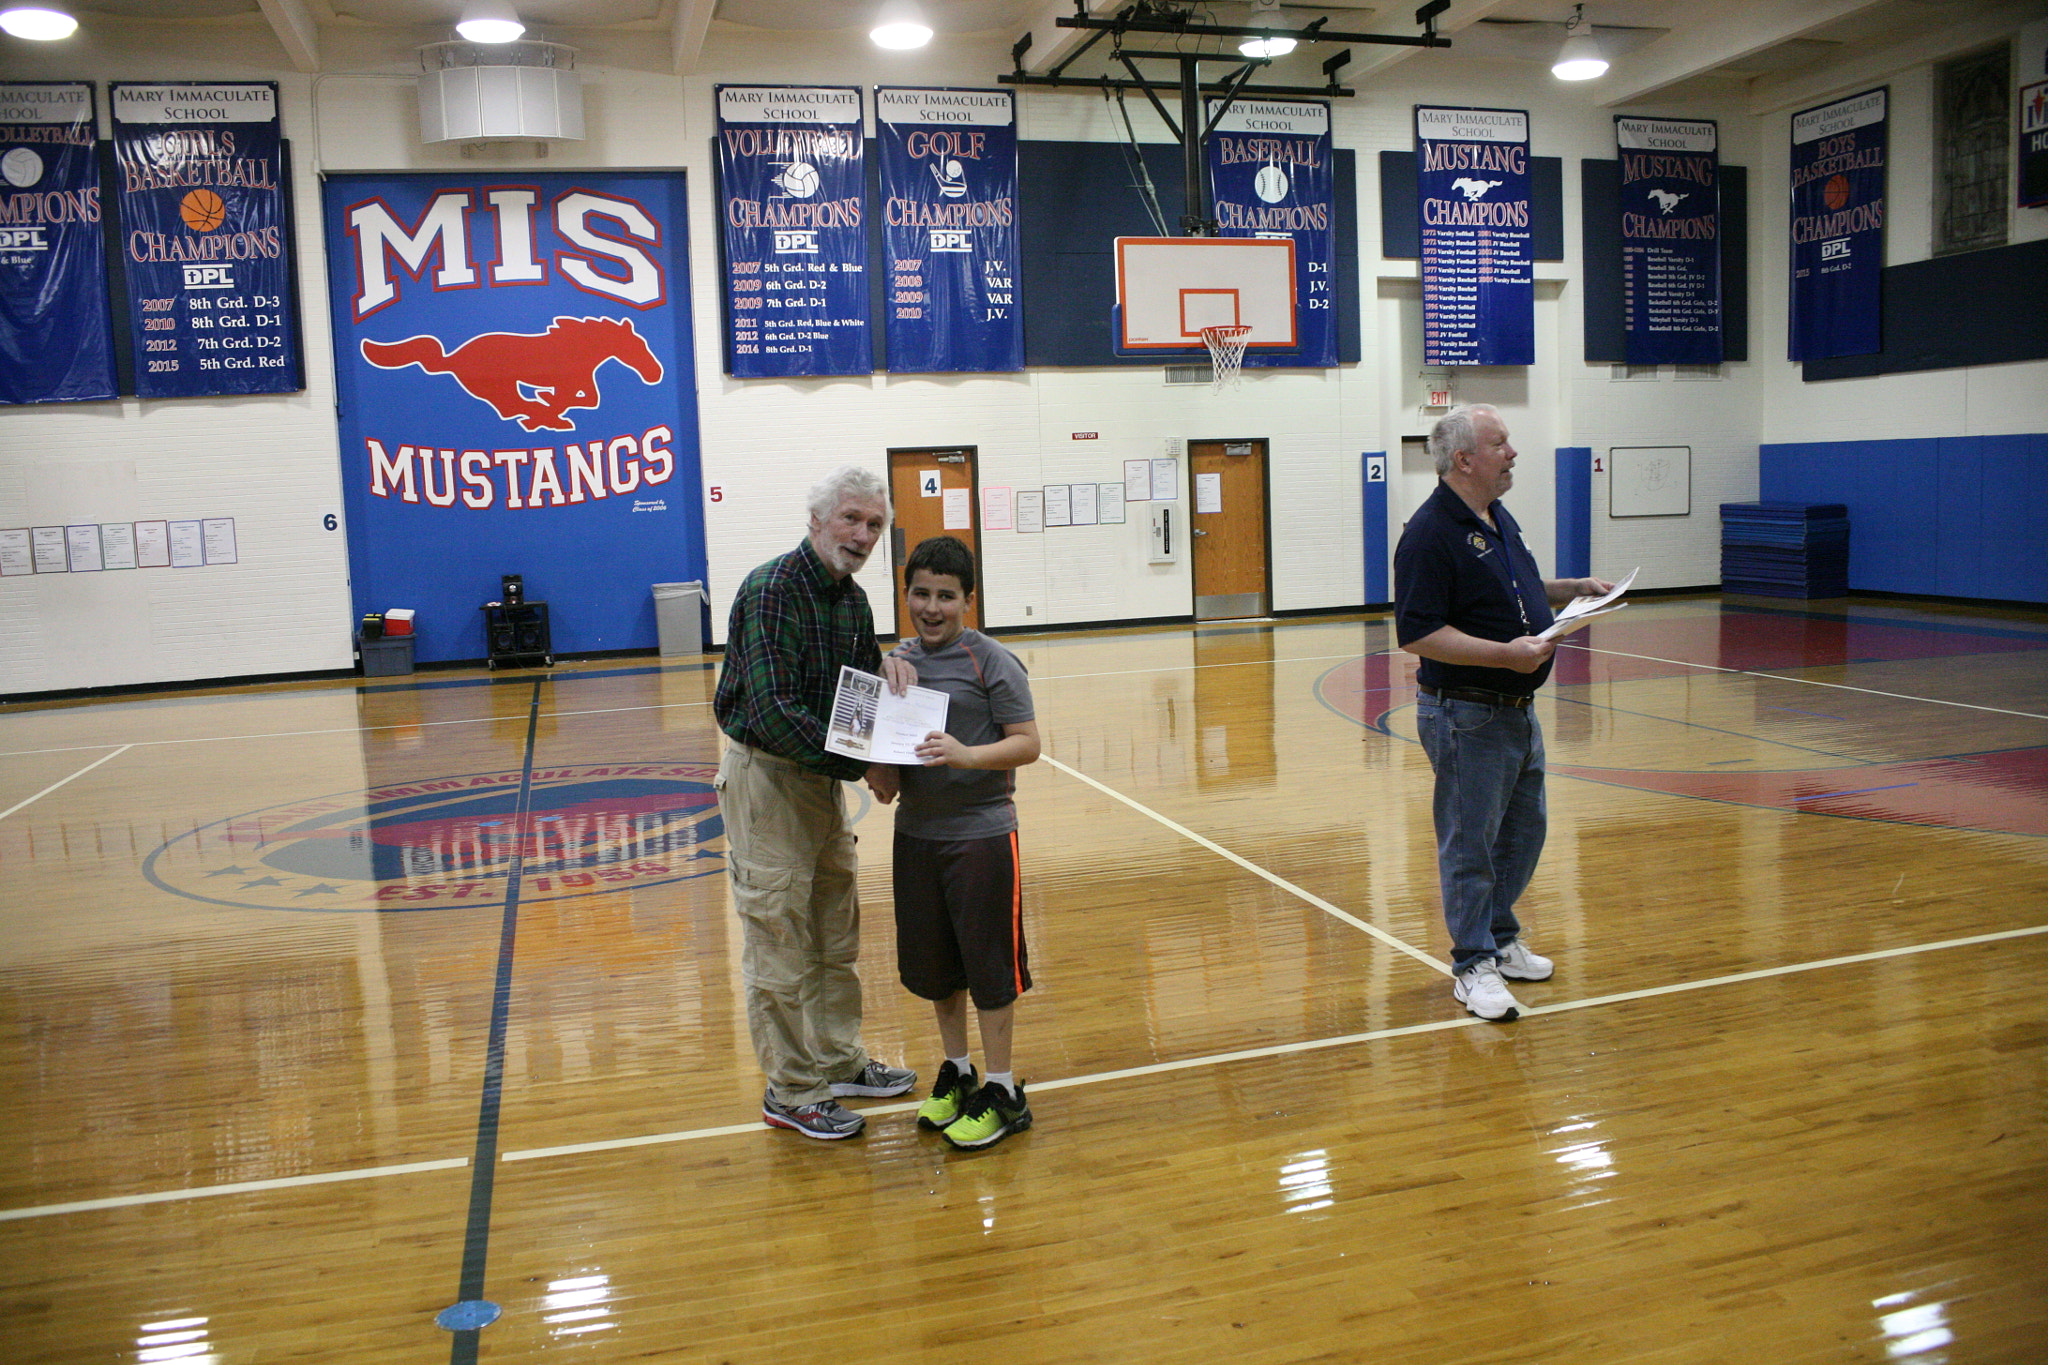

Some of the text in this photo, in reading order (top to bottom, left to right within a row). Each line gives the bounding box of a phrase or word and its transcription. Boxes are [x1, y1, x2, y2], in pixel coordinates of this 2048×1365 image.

[120, 88, 270, 102] MARY IMMACULATE
[724, 92, 855, 105] MARY IMMACULATE
[882, 93, 1008, 108] MARY IMMACULATE
[164, 106, 229, 120] SCHOOL
[763, 108, 819, 120] SCHOOL
[920, 109, 974, 122] SCHOOL
[1213, 102, 1324, 118] MRY IMMACULATE
[1796, 96, 1881, 130] MARY IMMACULATE
[1246, 118, 1294, 131] SCHOOL
[1422, 112, 1522, 126] MARY IMMACULATE
[1452, 126, 1495, 138] SCHOOL
[1621, 122, 1712, 136] MARY IMMACULATE
[1819, 118, 1855, 136] SCHOOL
[161, 130, 235, 156] GIRLS
[724, 130, 861, 160] VOLLEYBALL
[908, 131, 986, 160] GOLF
[1648, 136, 1688, 149] SCHOOL
[1818, 132, 1856, 160] BOYS
[1220, 138, 1320, 168] BASEBALL
[1423, 144, 1526, 174] MUSTANG
[1624, 154, 1712, 186] MUSTANG
[1793, 146, 1884, 188] BASKETBALL
[125, 158, 276, 192] BASKETBALL
[728, 197, 861, 228] CHAMPIONS
[886, 197, 1013, 228] CHAMPIONS
[1216, 200, 1328, 231] CHAMPIONS
[1423, 198, 1528, 227] CHAMPIONS
[1623, 212, 1716, 240] CHAMPIONS
[1792, 199, 1883, 244] CHAMPIONS
[130, 226, 280, 262] CHAMPIONS
[775, 234, 818, 250] DPL
[930, 234, 972, 249] DPL
[344, 184, 666, 325] MIS
[1822, 242, 1851, 258] DPL
[11, 256, 32, 264] Blue
[894, 260, 1006, 274] 2007 J.V.
[1308, 262, 1328, 273] D-1
[732, 262, 863, 274] 2007 5th Grd. Red & Blue
[184, 269, 234, 284] DPL
[986, 278, 1012, 288] VAR
[766, 281, 781, 290] 6th
[784, 280, 806, 290] Grd.
[810, 280, 826, 290] D-2
[1310, 280, 1329, 292] J.V.
[142, 296, 280, 312] 2007 8th Grd. D-3
[766, 298, 782, 308] 7th
[785, 298, 806, 308] Grd.
[810, 298, 826, 308] D-1
[986, 293, 1013, 304] VAR
[1309, 298, 1329, 310] D-2
[144, 315, 282, 330] 2010 8th Grd. D-1
[986, 308, 1008, 322] J.V.
[735, 318, 758, 328] 2011
[764, 320, 776, 328] 5th
[778, 320, 795, 328] Grd.
[842, 318, 864, 326] White
[736, 332, 758, 340] 2012
[779, 332, 796, 340] Grd.
[798, 332, 812, 340] D-2
[813, 332, 829, 340] Blue
[146, 336, 282, 352] 2012 7th Grd. D-2
[766, 346, 778, 354] 8th
[148, 356, 285, 373] 2015 5th Grd. Red
[1432, 392, 1448, 405] EXIT
[365, 424, 675, 510] MUSTANGS
[1370, 464, 1381, 480] 2
[1594, 458, 1604, 472] 1
[924, 477, 938, 494] 4
[710, 486, 722, 502] 5
[324, 514, 338, 532] 6
